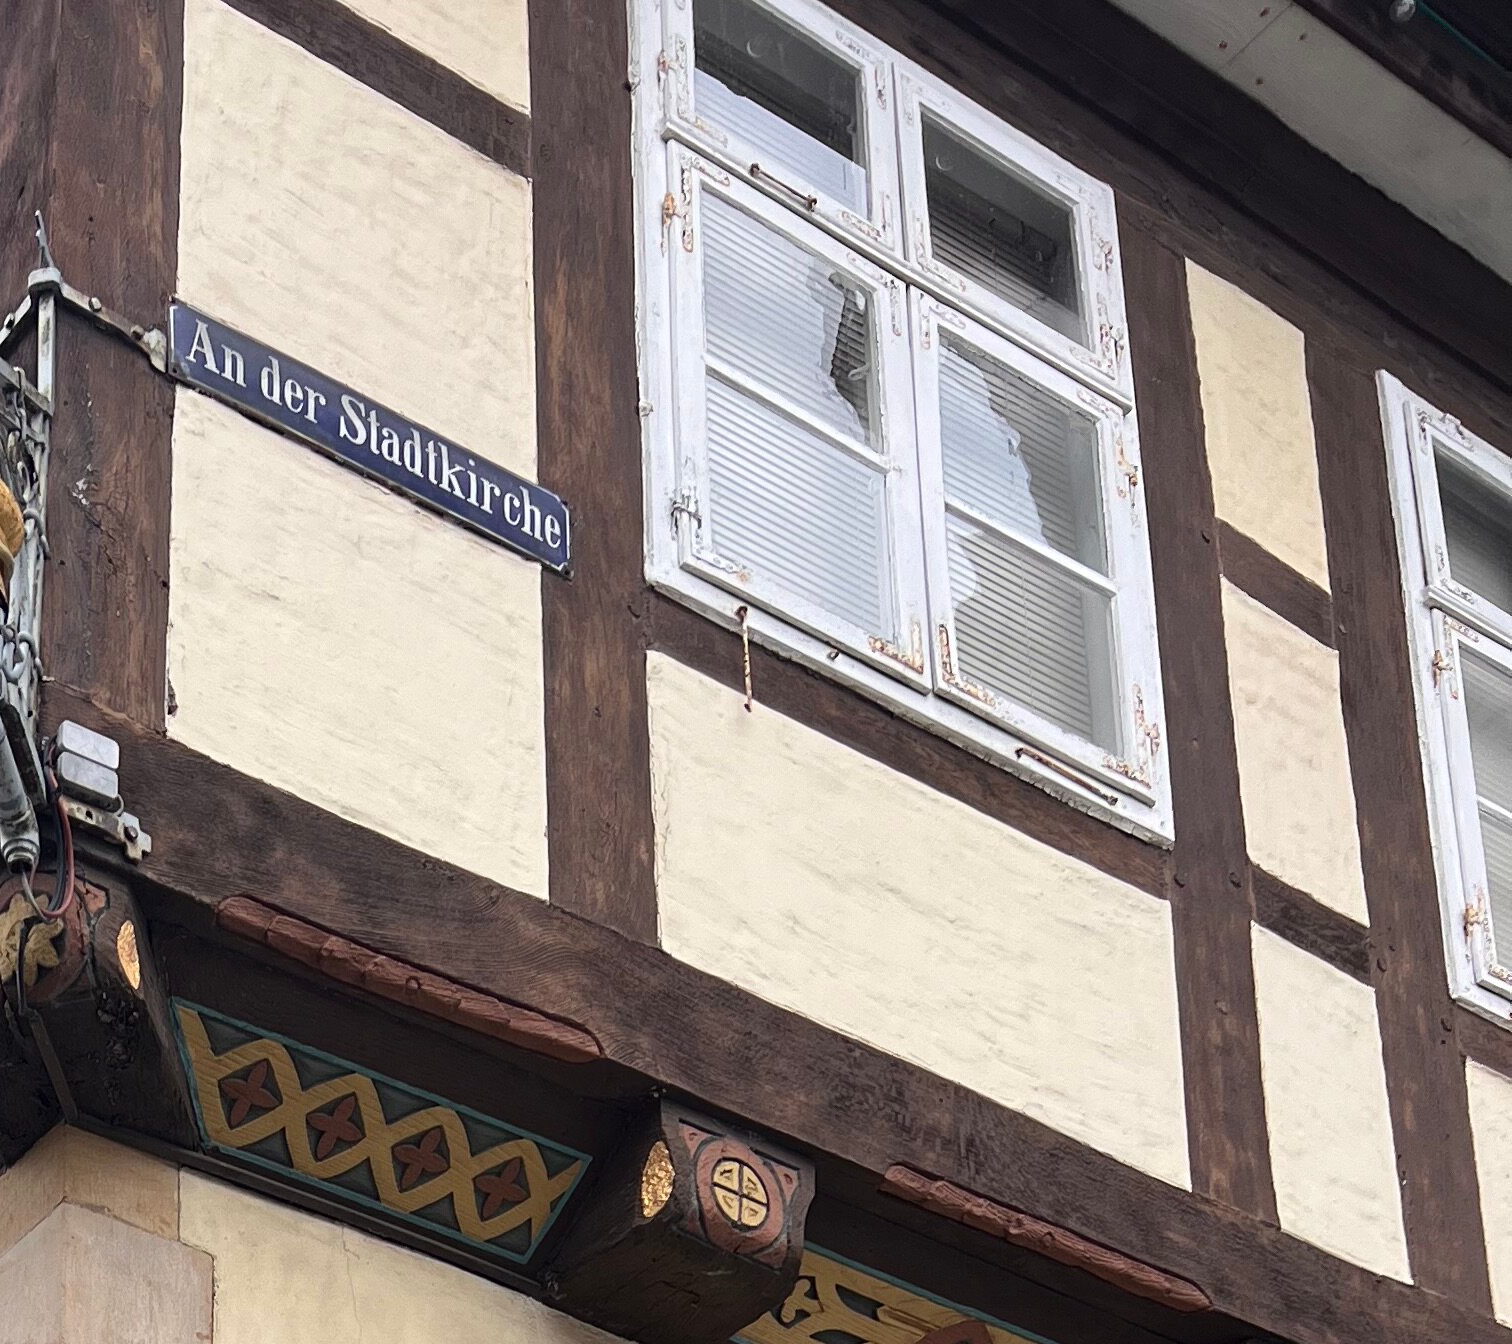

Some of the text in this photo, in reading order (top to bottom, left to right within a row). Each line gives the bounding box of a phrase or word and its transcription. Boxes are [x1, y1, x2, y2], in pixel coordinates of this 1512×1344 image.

[188, 319, 561, 549] An der Stadtkirche
